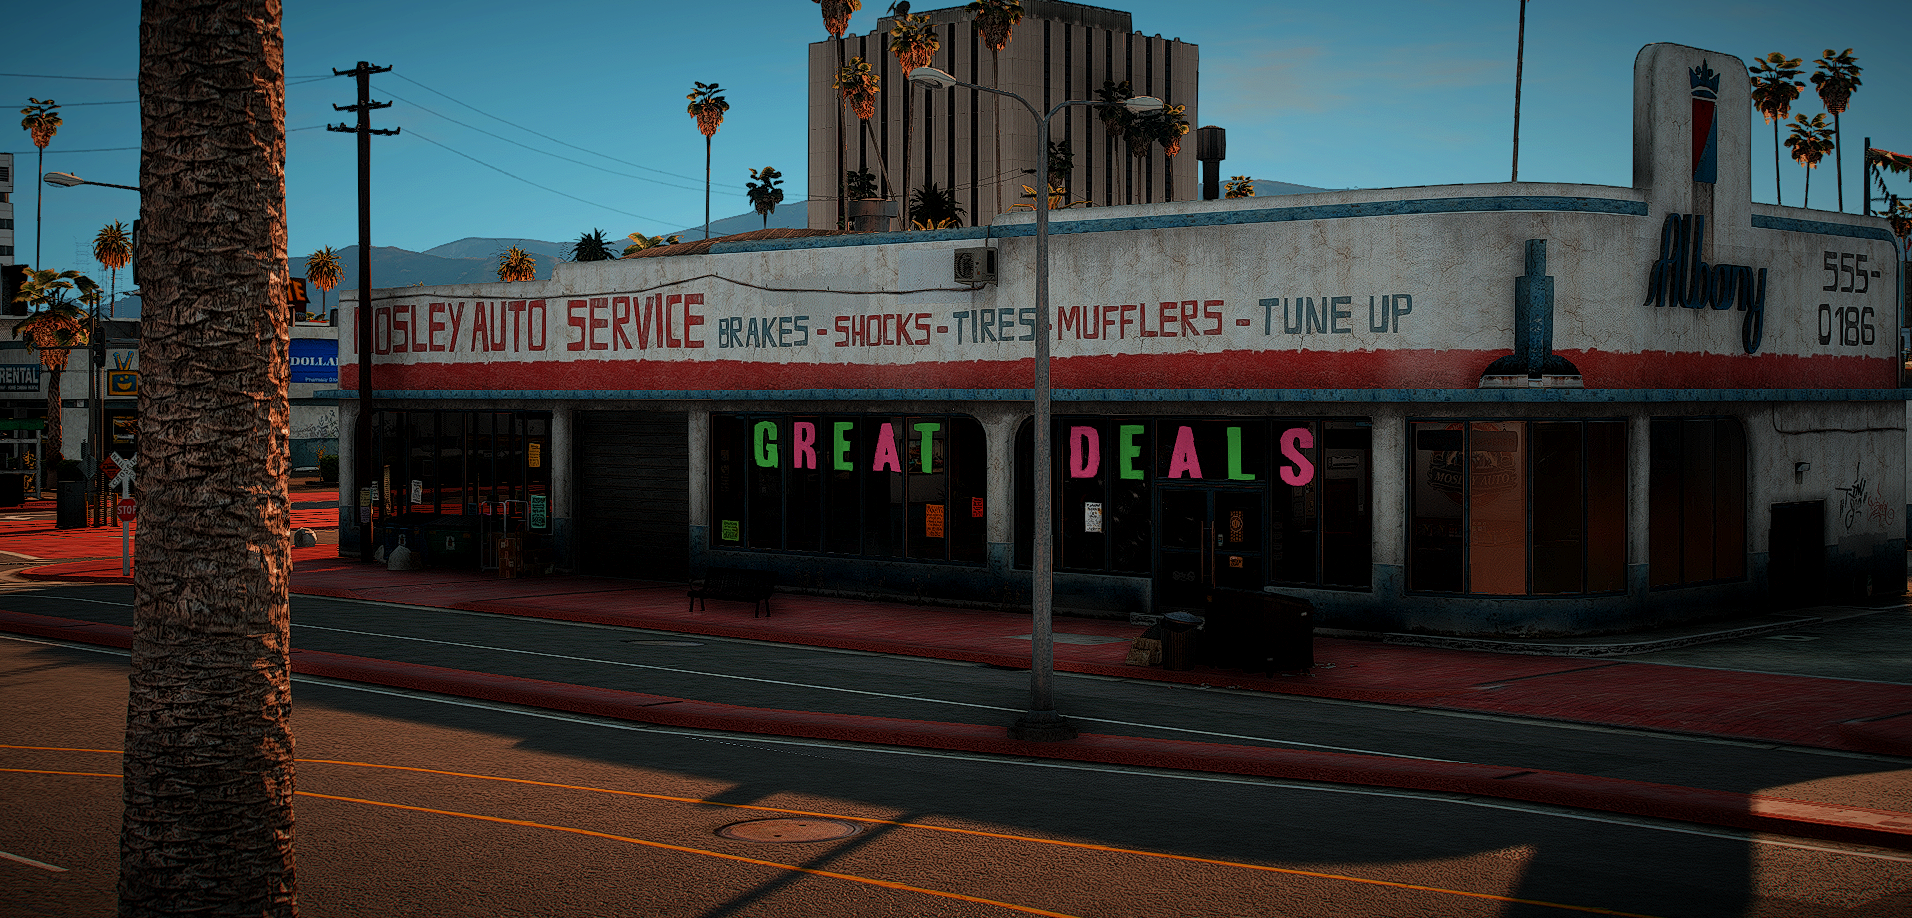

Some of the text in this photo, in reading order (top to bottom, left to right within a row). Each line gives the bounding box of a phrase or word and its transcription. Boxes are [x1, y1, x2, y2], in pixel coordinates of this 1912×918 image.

[1823, 251, 1880, 293] 555-
[470, 299, 546, 352] AUTO
[567, 293, 704, 351] SERVICE
[718, 315, 810, 349] BRAKES
[834, 312, 932, 347] SHOCKS
[952, 307, 1037, 345] TIRES
[1057, 299, 1225, 341] MUFFLERS
[1258, 295, 1353, 335] TUNE
[1369, 293, 1413, 334] UP
[1818, 303, 1875, 347] 0186
[0, 367, 39, 384] RENTAL
[753, 420, 942, 475] GREAT
[1069, 424, 1316, 488] DEALS
[117, 505, 136, 515] STOP
